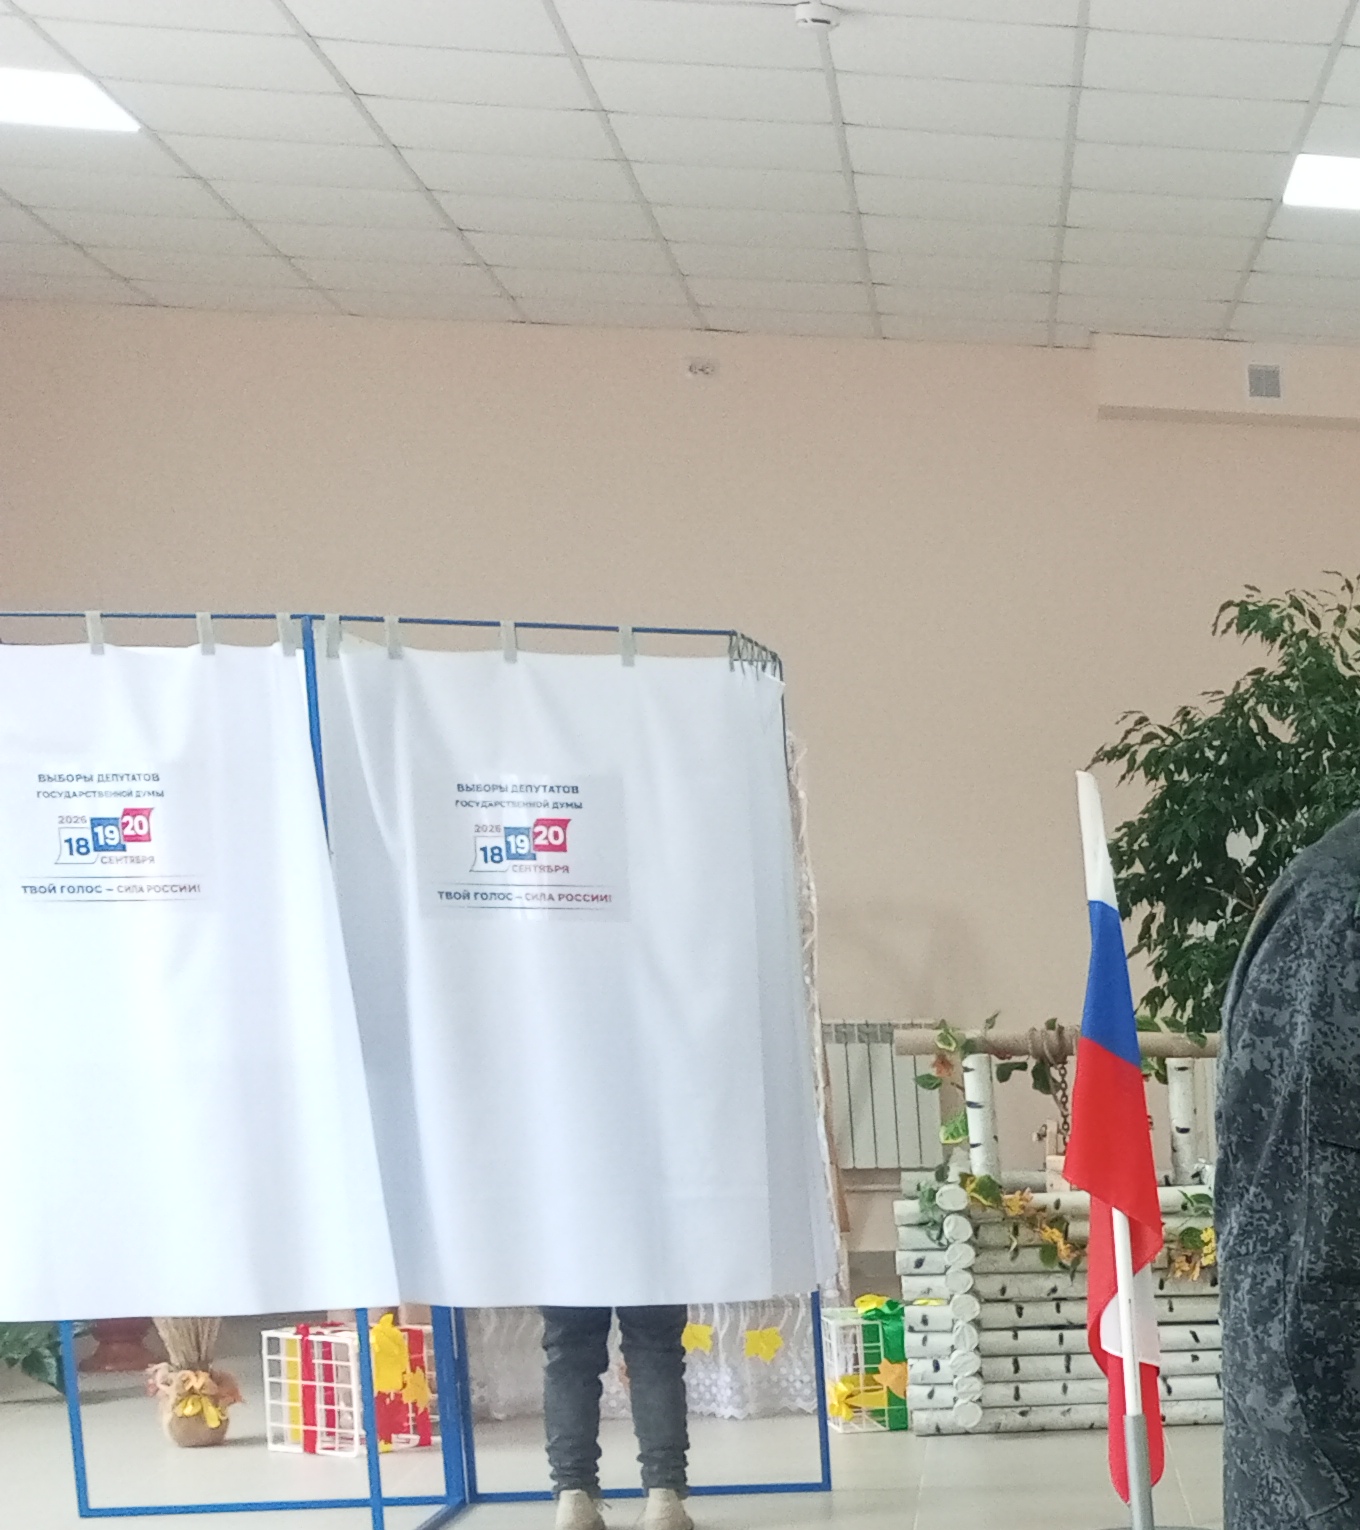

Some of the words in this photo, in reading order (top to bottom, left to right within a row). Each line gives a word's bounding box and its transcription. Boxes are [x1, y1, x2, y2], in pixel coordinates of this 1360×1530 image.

[38, 774, 94, 783] ВЫБОРЫ
[97, 773, 160, 783] ДЕПУТАТОВ
[457, 783, 508, 793] ВЫБОРЫ
[511, 784, 579, 794] ДЕПУТАТОВ
[552, 801, 583, 810] ДУМЫ
[58, 815, 87, 824] 2026
[474, 824, 501, 833] 2026
[64, 837, 91, 856] 18
[93, 825, 120, 845] 19
[121, 815, 149, 835] 20
[480, 845, 504, 864] 18
[507, 834, 530, 854] 19
[533, 825, 565, 846] 20
[100, 855, 155, 864] СЕНТЯБРЯ
[512, 864, 570, 873] СЕНТЯБРЯ
[21, 883, 57, 894] ТВОЙ
[60, 885, 102, 894] ГОЛОС
[116, 885, 144, 893] СИЛА
[438, 889, 470, 900] ТВОЙ
[474, 892, 513, 901] ГОЛОС
[525, 892, 555, 902] СИЛА
